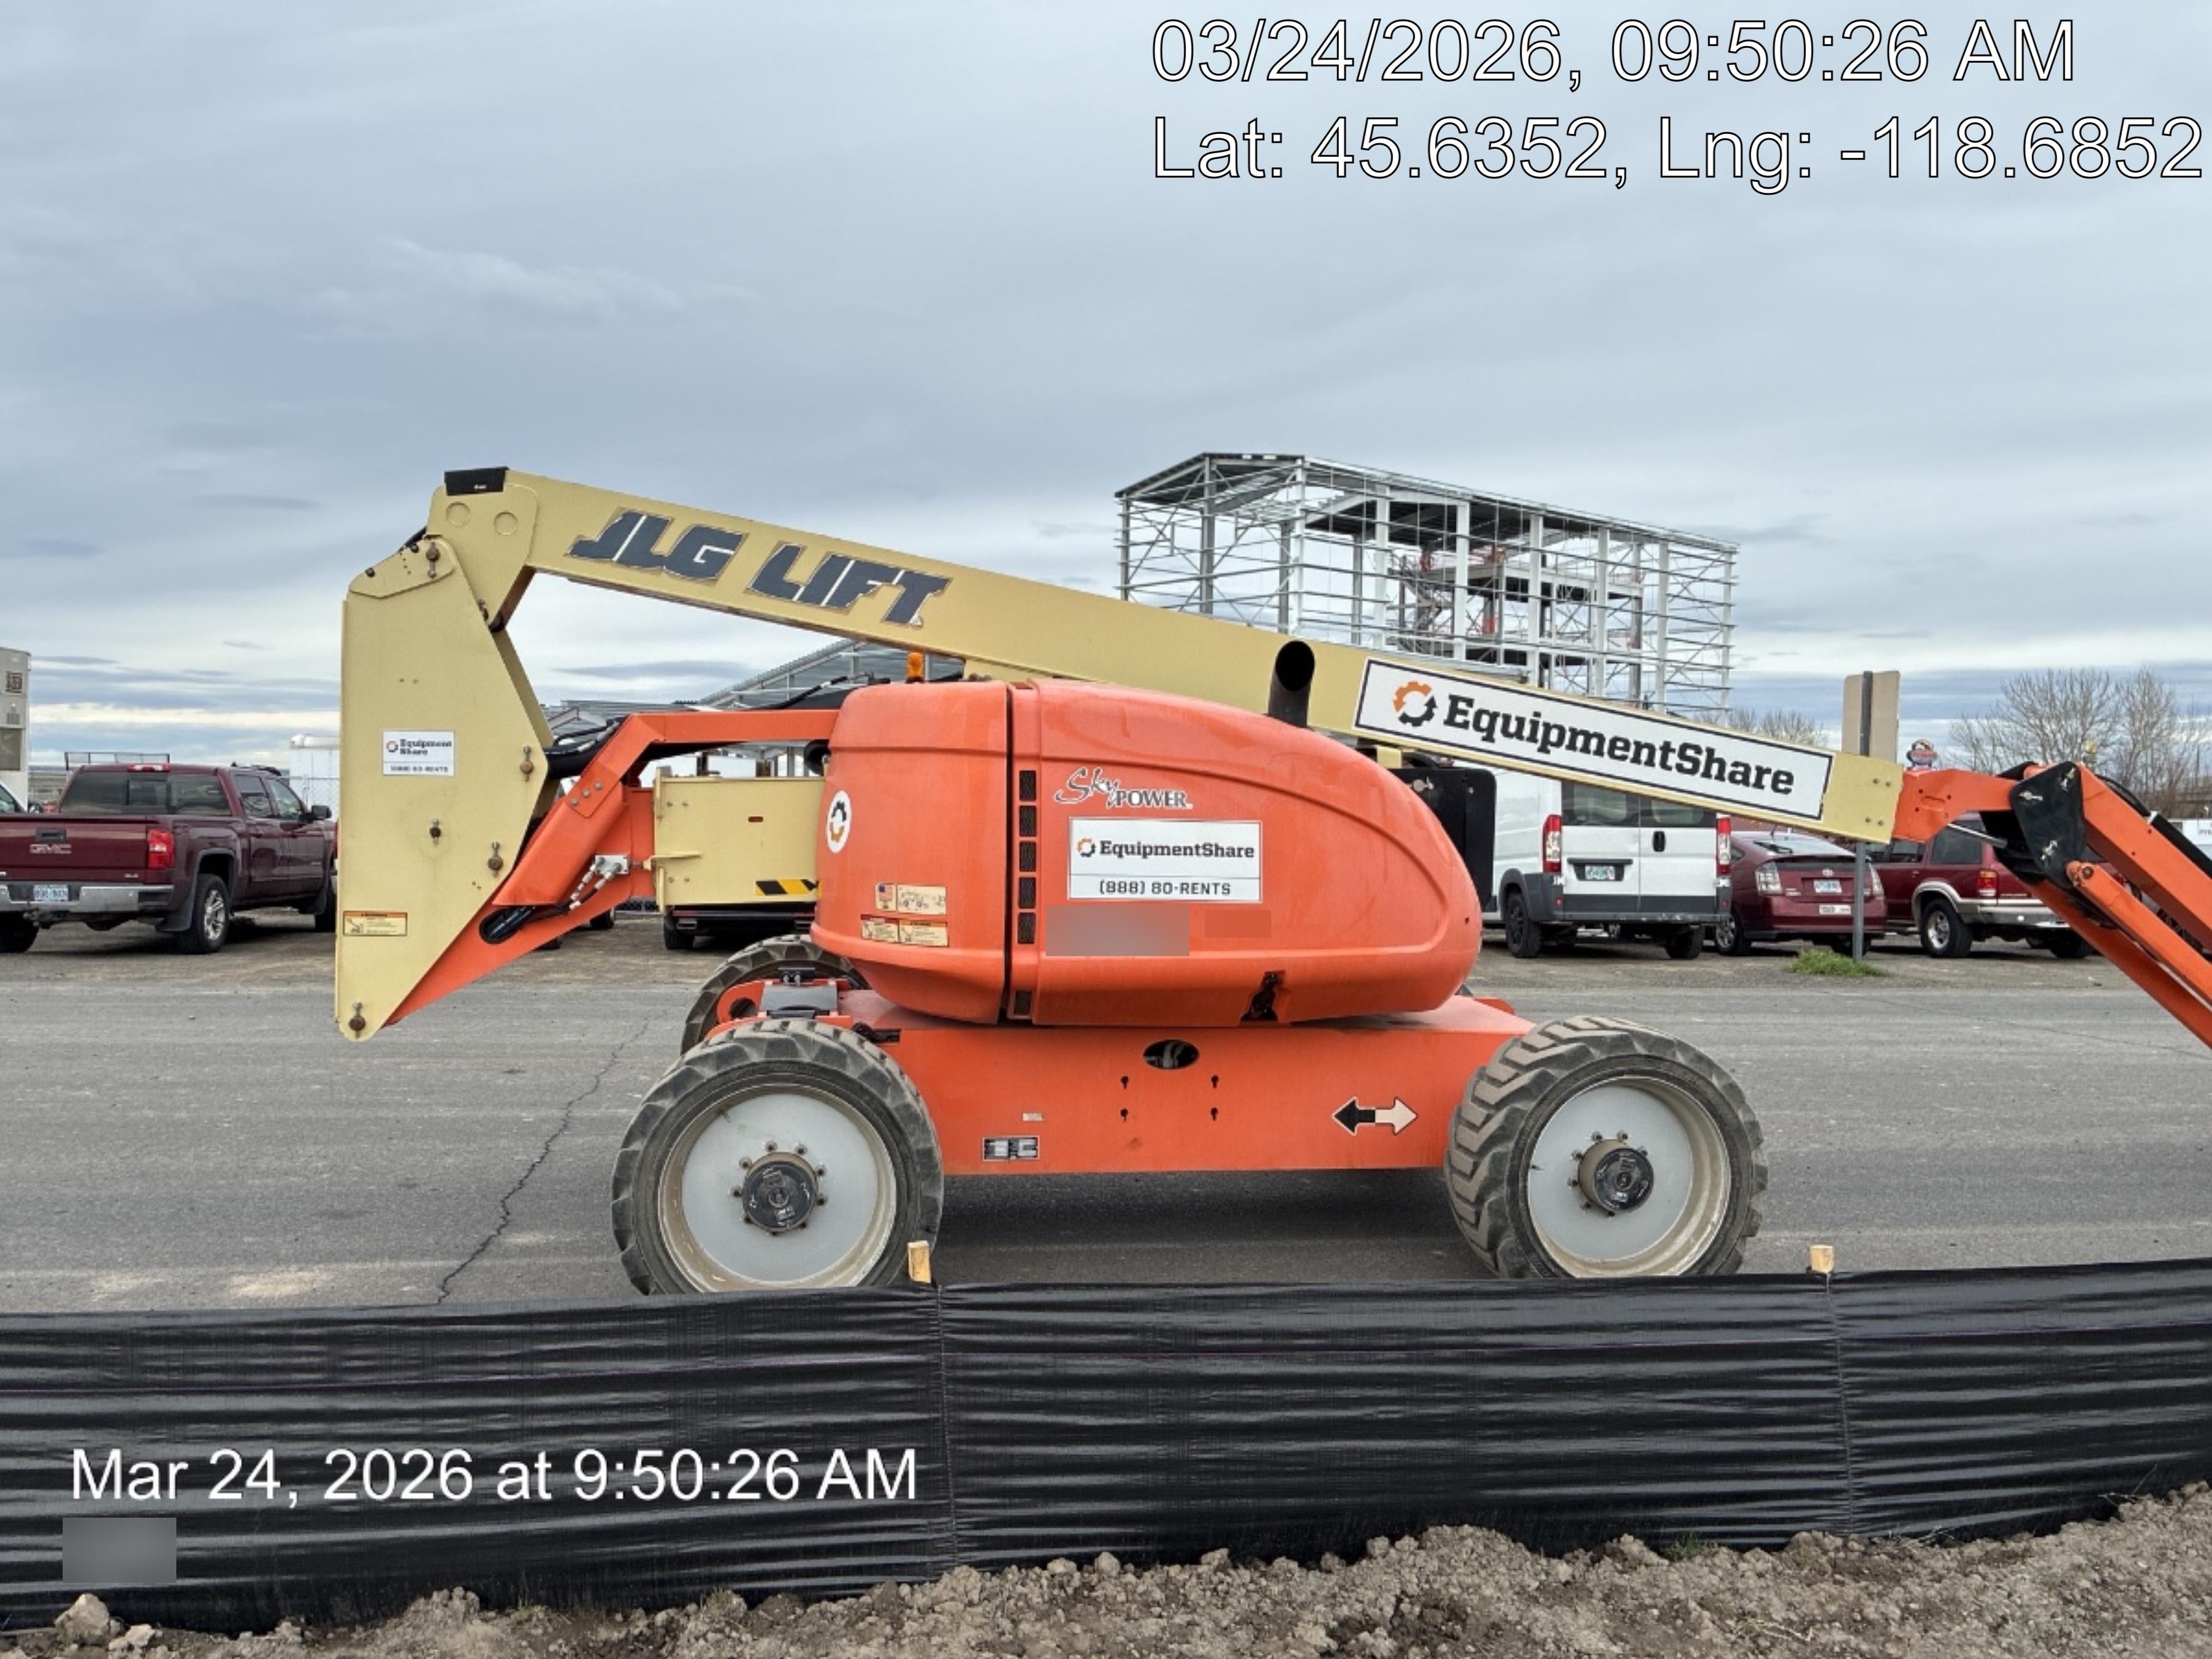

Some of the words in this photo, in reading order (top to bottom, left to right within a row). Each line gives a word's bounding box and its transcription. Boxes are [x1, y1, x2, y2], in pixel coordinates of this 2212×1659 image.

[565, 510, 745, 581] JLG
[748, 543, 951, 625] LIFT
[1443, 693, 1795, 795] EquipmentShare
[1055, 767, 1119, 809] Sky
[1115, 790, 1188, 807] POWER
[30, 844, 72, 854] GMC
[1099, 840, 1255, 859] EquipmentShare
[1099, 880, 1146, 895] (888)
[1151, 881, 1231, 896] 80-RENTS
